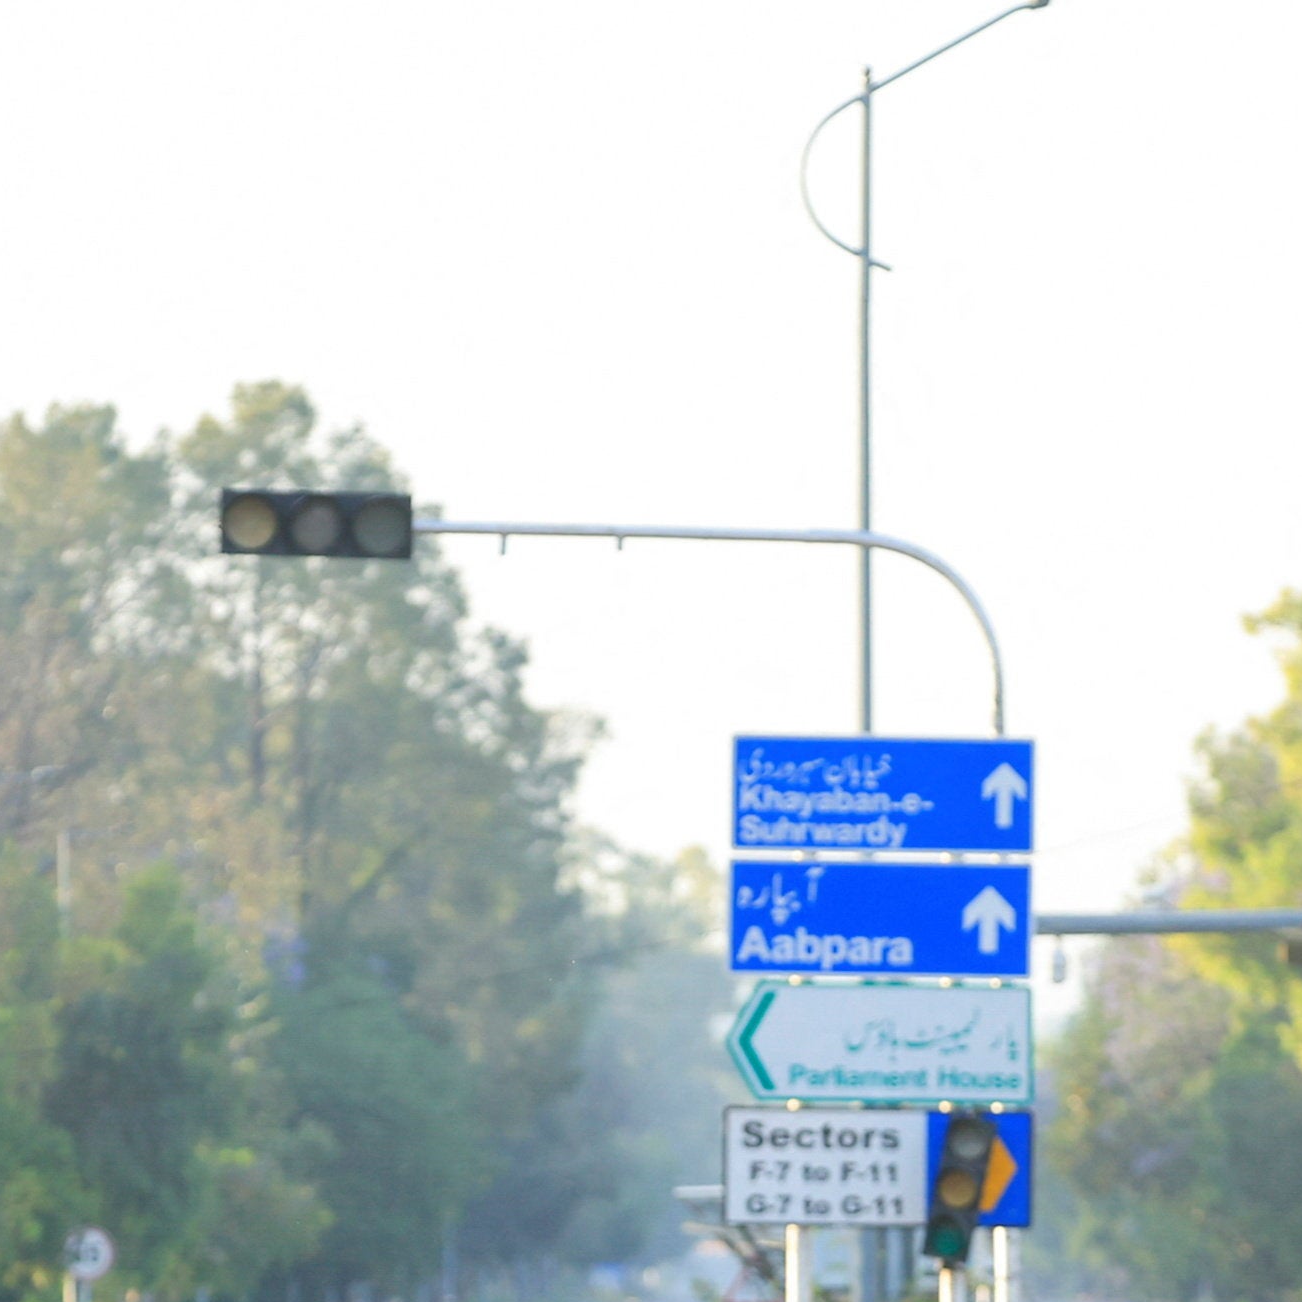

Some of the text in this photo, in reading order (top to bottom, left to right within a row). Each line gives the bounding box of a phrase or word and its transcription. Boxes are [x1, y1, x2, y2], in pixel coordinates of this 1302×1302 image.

[736, 925, 914, 971] Aabpara
[788, 1062, 1022, 1090] Parliament House
[742, 1121, 900, 1149] Sectors
[749, 1160, 899, 1182] F-7 to F-11
[745, 1193, 904, 1216] G-7 to G-11
